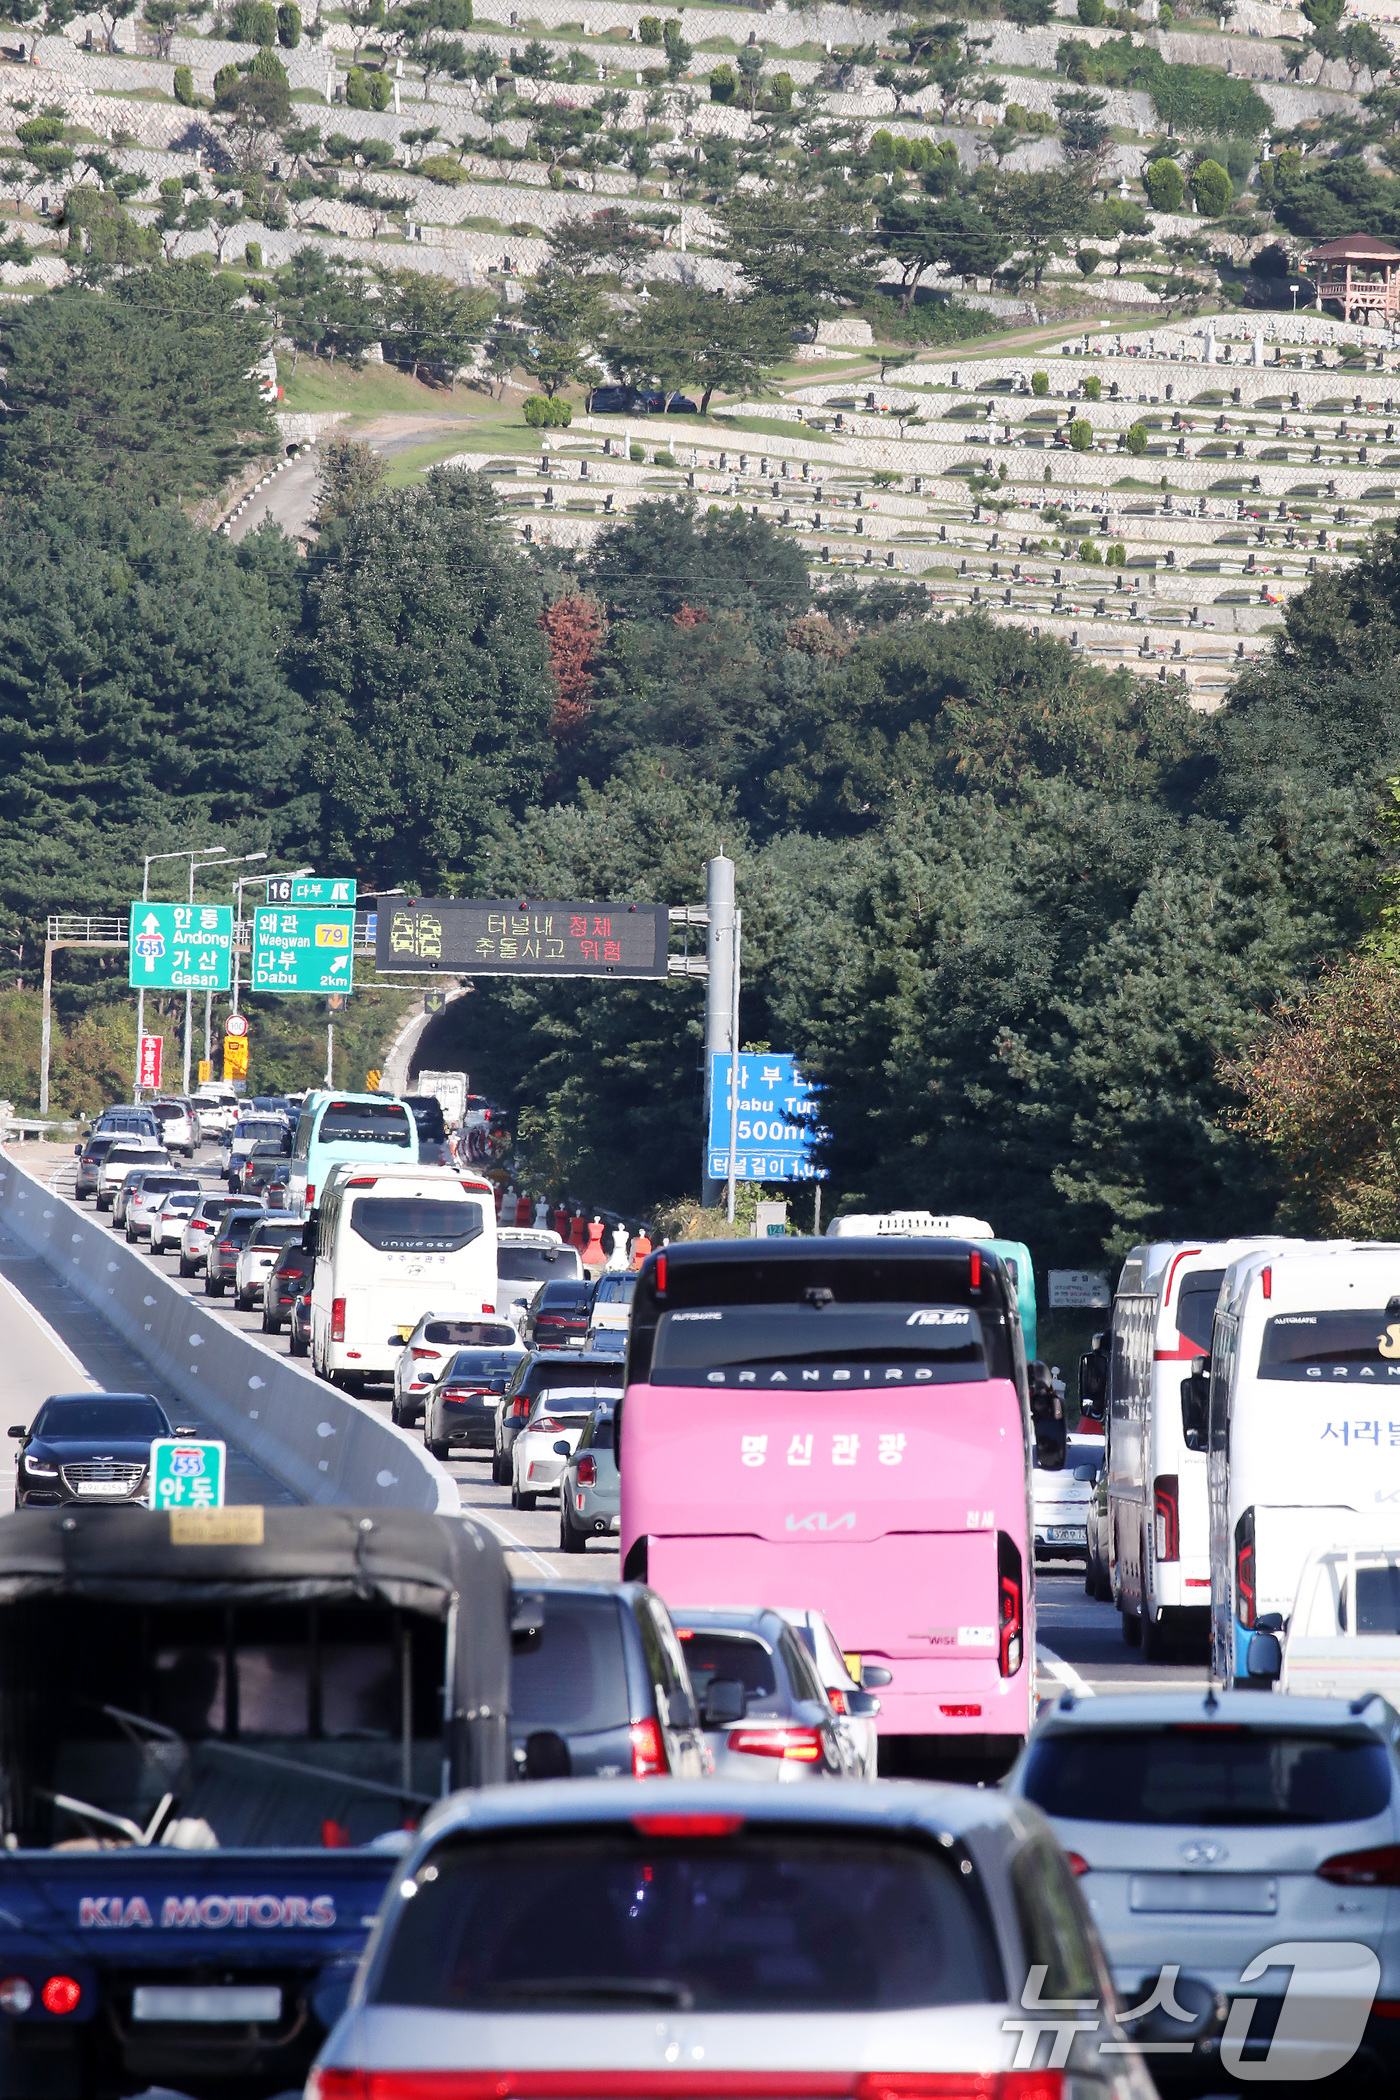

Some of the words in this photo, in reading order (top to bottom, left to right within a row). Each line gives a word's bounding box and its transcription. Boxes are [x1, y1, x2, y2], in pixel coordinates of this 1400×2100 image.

[270, 882, 290, 899] 16
[297, 884, 323, 897] 다부
[173, 907, 219, 929] 안동
[259, 914, 299, 934] 왜관
[488, 914, 553, 936] 터널내
[569, 916, 611, 938] 정체
[172, 930, 230, 948] Andong
[259, 932, 311, 949] Waegwan
[321, 929, 344, 943] 79
[142, 941, 160, 956] 55
[475, 937, 565, 959] 추돌사고
[580, 939, 621, 961] 위험
[173, 950, 218, 970] 가산
[257, 951, 298, 971] 다부
[170, 971, 219, 987] Gasan
[256, 970, 298, 985] Dabu
[319, 975, 348, 987] 2km
[230, 1022, 244, 1031] 100
[143, 1038, 157, 1087] 추돌주의
[737, 1120, 805, 1141] 500m
[671, 1312, 723, 1321] AUTOMATIC
[707, 1368, 933, 1382] GRANBIRD
[177, 1457, 200, 1473] 55
[159, 1477, 214, 1510] 안동
[79, 1896, 153, 1928] KIA
[160, 1896, 337, 1928] MOTORS
